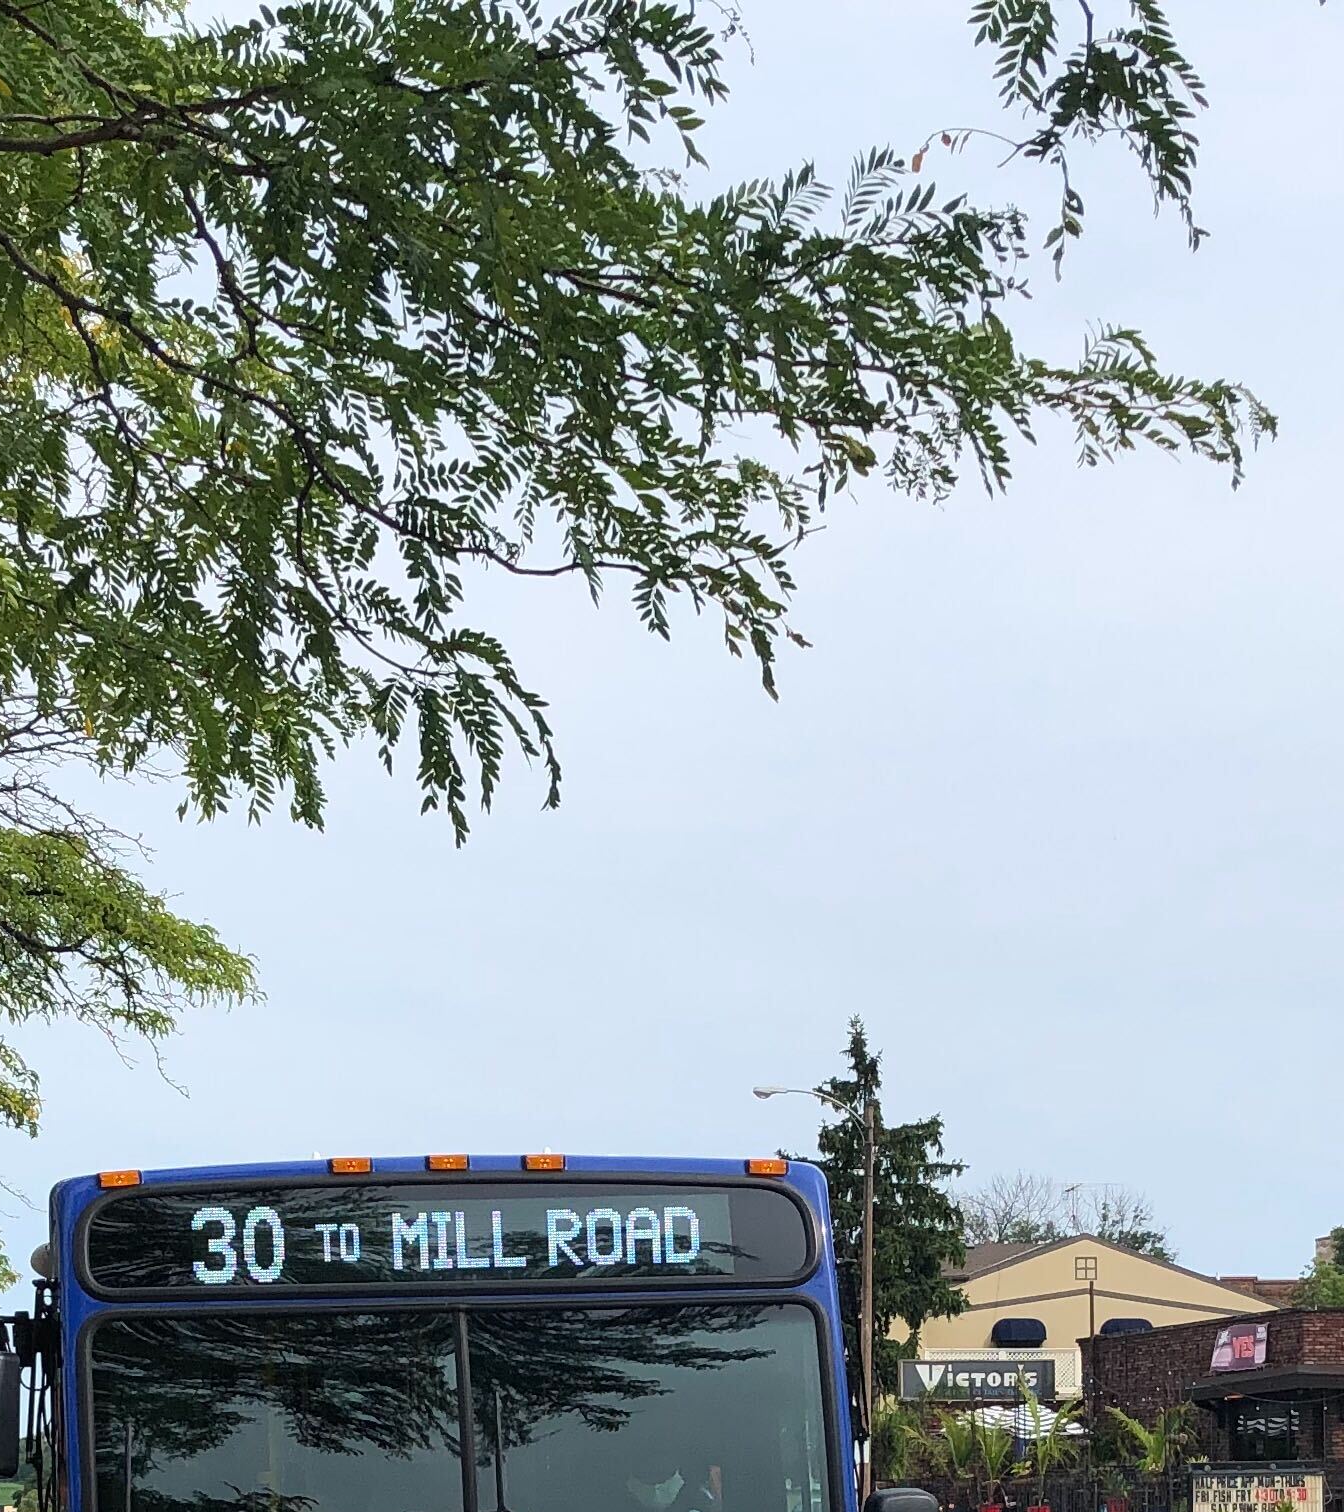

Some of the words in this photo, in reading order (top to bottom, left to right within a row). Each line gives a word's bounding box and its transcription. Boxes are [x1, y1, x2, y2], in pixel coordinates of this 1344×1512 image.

[190, 1206, 284, 1284] 30
[315, 1223, 360, 1262] TO
[391, 1210, 526, 1270] MILL
[547, 1207, 700, 1266] ROAD
[1213, 1489, 1232, 1503] FISH
